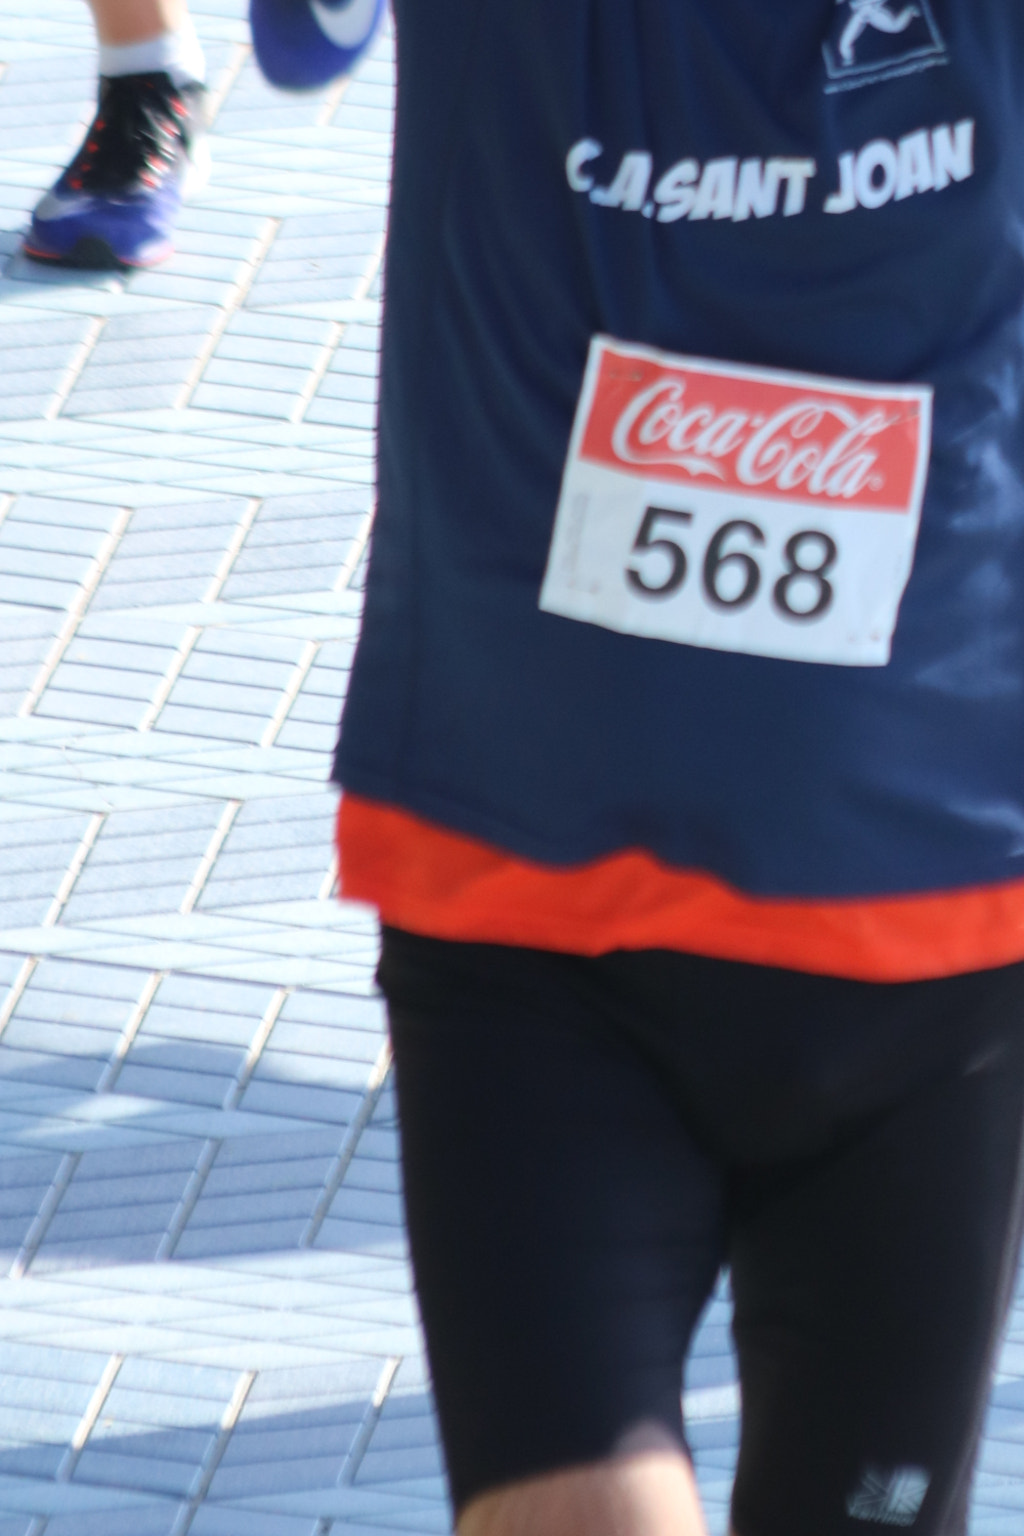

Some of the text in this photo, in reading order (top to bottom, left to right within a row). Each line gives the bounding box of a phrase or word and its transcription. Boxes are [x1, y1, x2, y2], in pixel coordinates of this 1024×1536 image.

[823, 118, 975, 214] JOAN
[611, 375, 892, 499] Coca-Cola
[624, 505, 838, 626] 568
